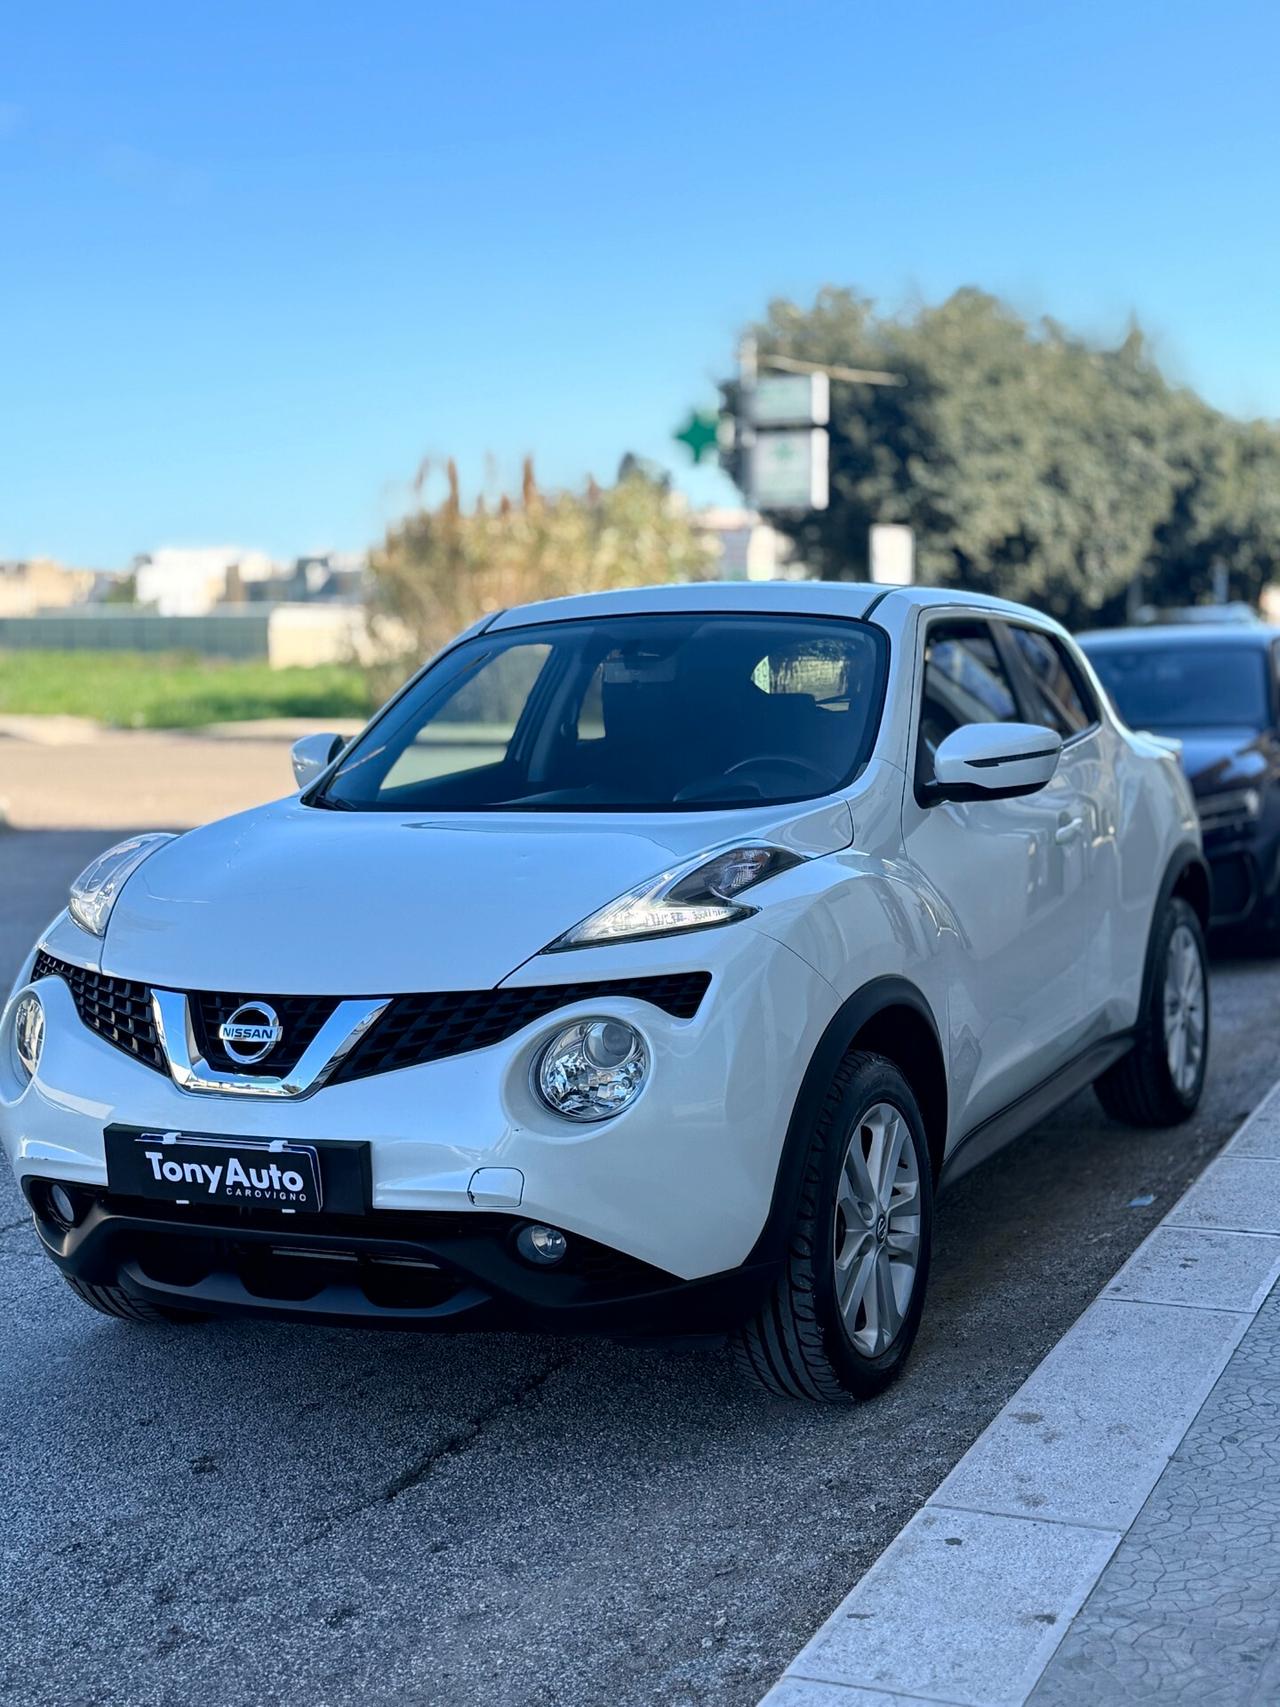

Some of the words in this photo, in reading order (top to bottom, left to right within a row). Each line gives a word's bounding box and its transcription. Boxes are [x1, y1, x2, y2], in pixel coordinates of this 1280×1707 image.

[222, 1026, 273, 1040] NISSAN
[145, 1151, 304, 1194] TonyAuto
[226, 1187, 307, 1202] CAROVIGNO
